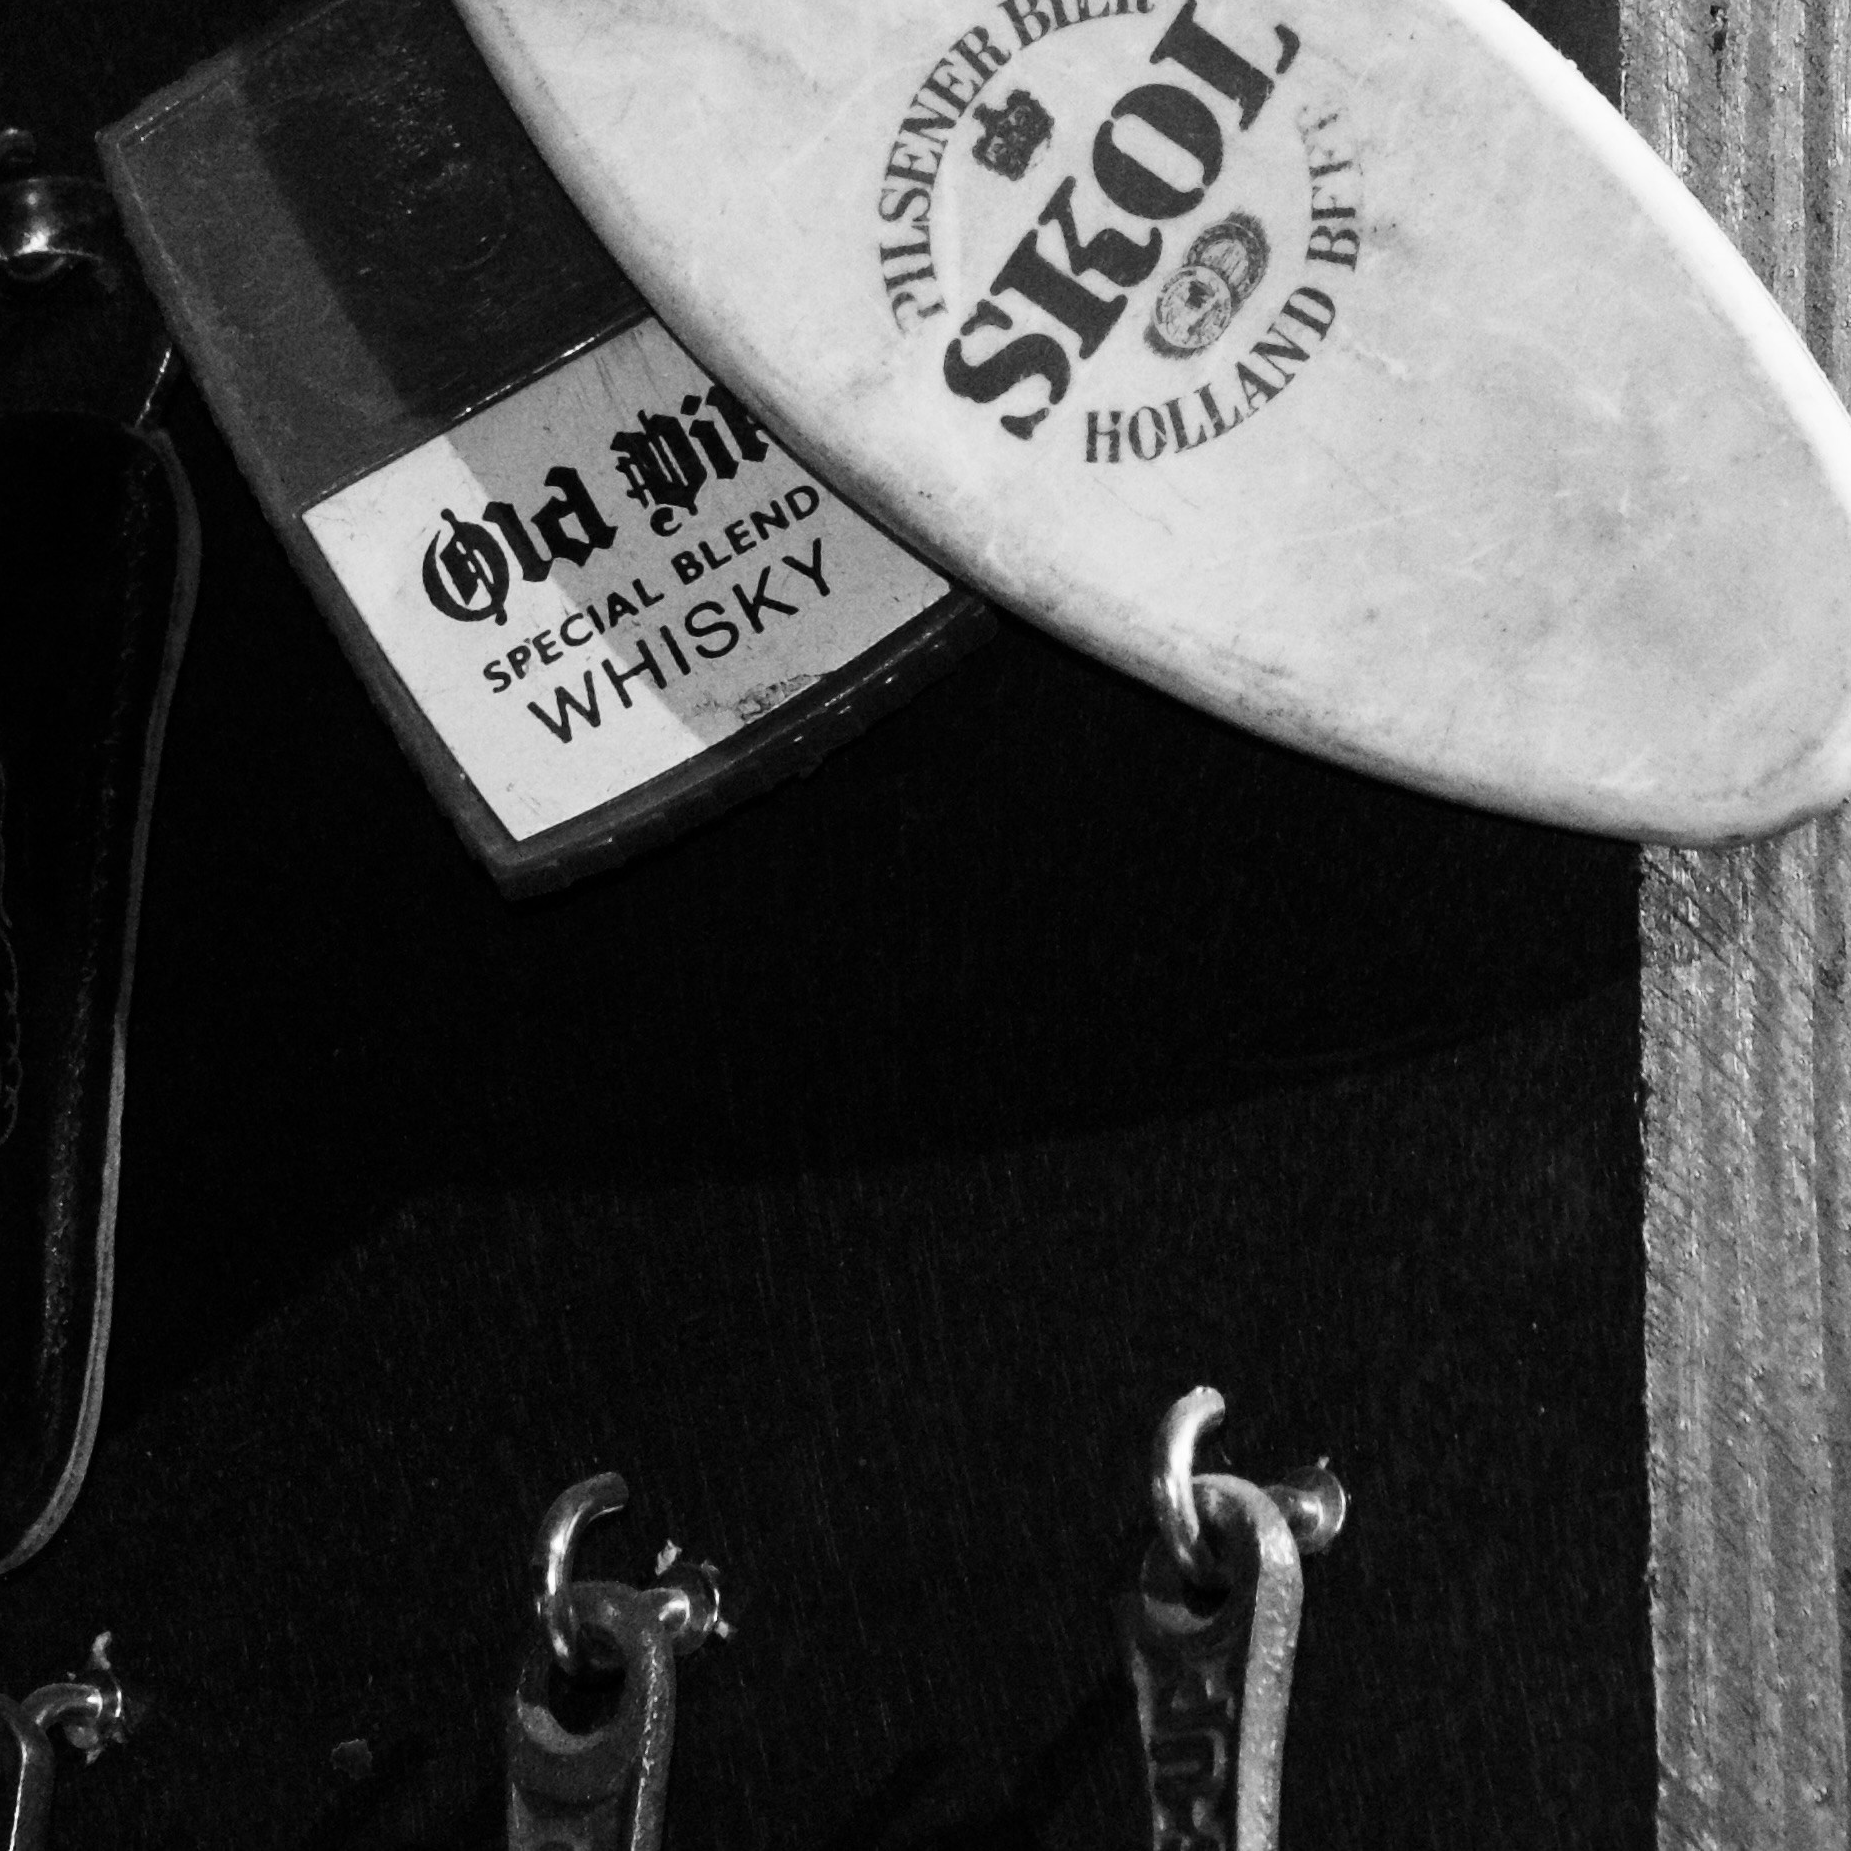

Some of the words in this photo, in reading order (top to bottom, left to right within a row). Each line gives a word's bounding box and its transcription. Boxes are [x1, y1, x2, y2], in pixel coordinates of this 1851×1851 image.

[878, 25, 1012, 337] PILSENER
[1085, 285, 1338, 464] HOLLAND
[422, 465, 618, 626] Old
[482, 577, 666, 694] SPECIAL
[671, 484, 822, 586] BLEND
[527, 537, 831, 745] WHISKY
